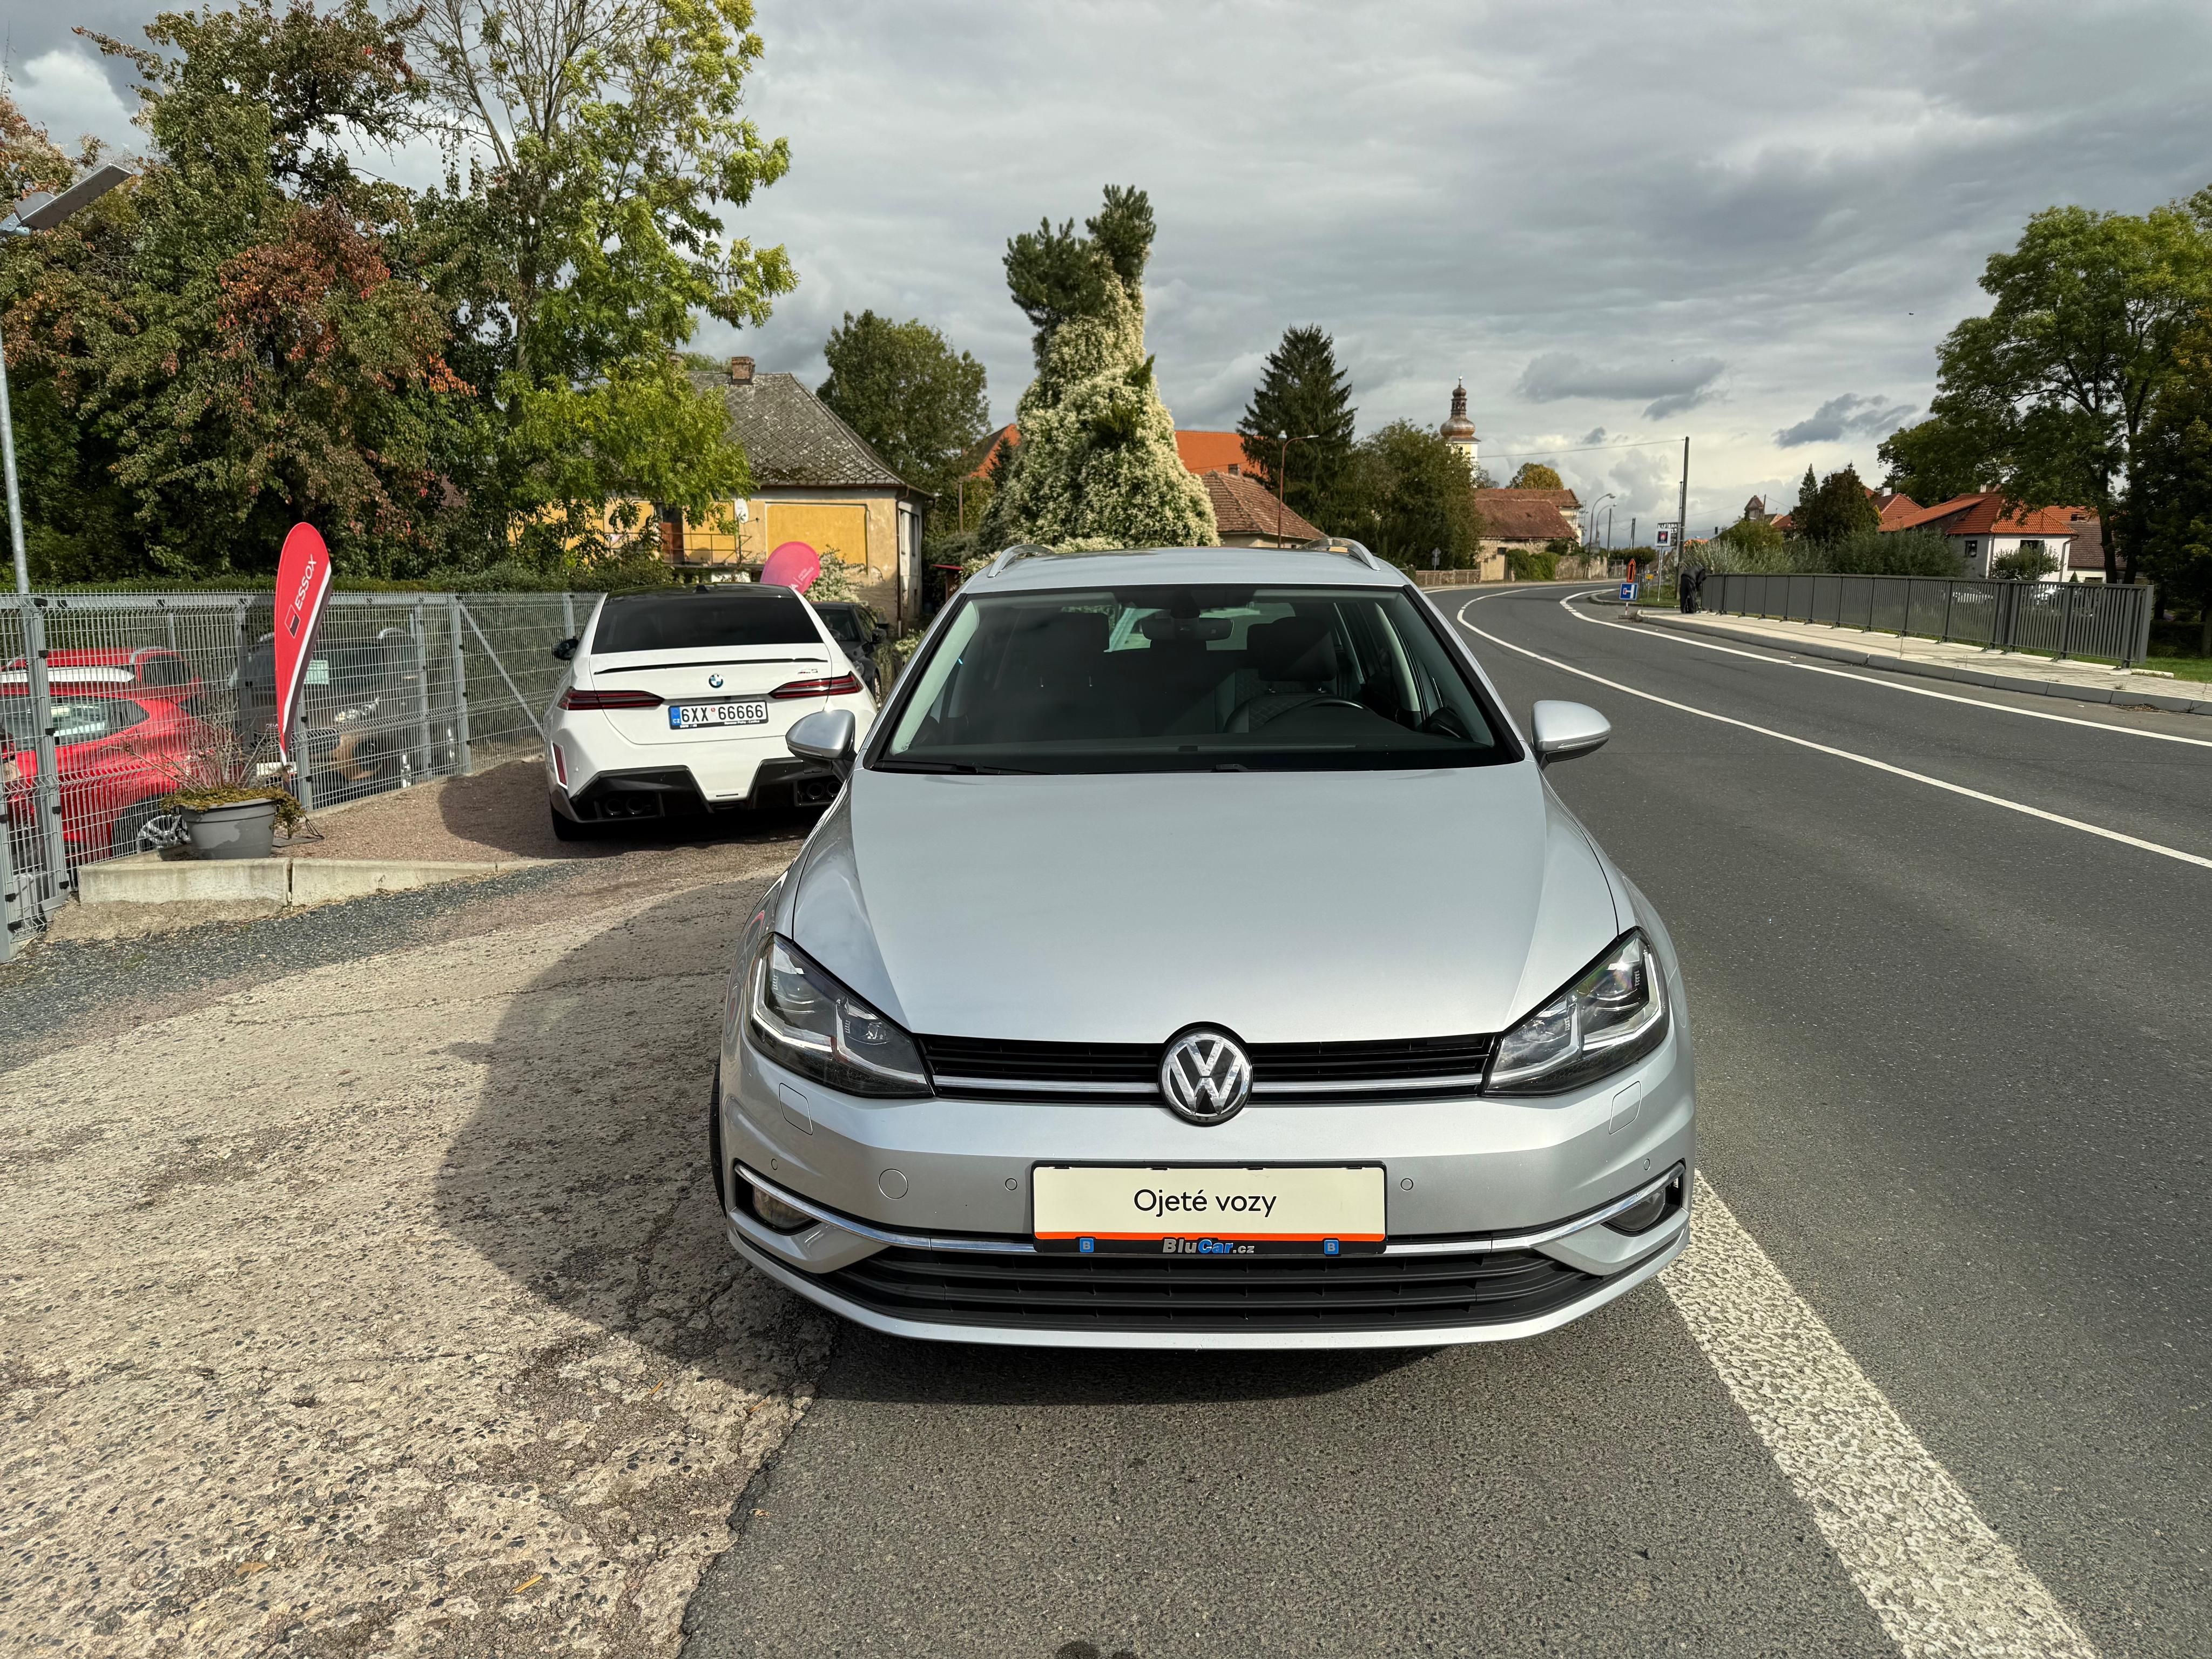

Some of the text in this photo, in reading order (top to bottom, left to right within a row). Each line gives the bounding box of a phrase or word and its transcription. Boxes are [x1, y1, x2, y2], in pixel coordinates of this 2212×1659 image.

[294, 554, 317, 611] ESSOX
[681, 704, 764, 723] 6XX 66666
[1134, 1189, 1277, 1218] Ojeté vozy
[1082, 1241, 1091, 1251] B
[1162, 1238, 1255, 1254] BluCar.cz
[1327, 1242, 1336, 1252] B
